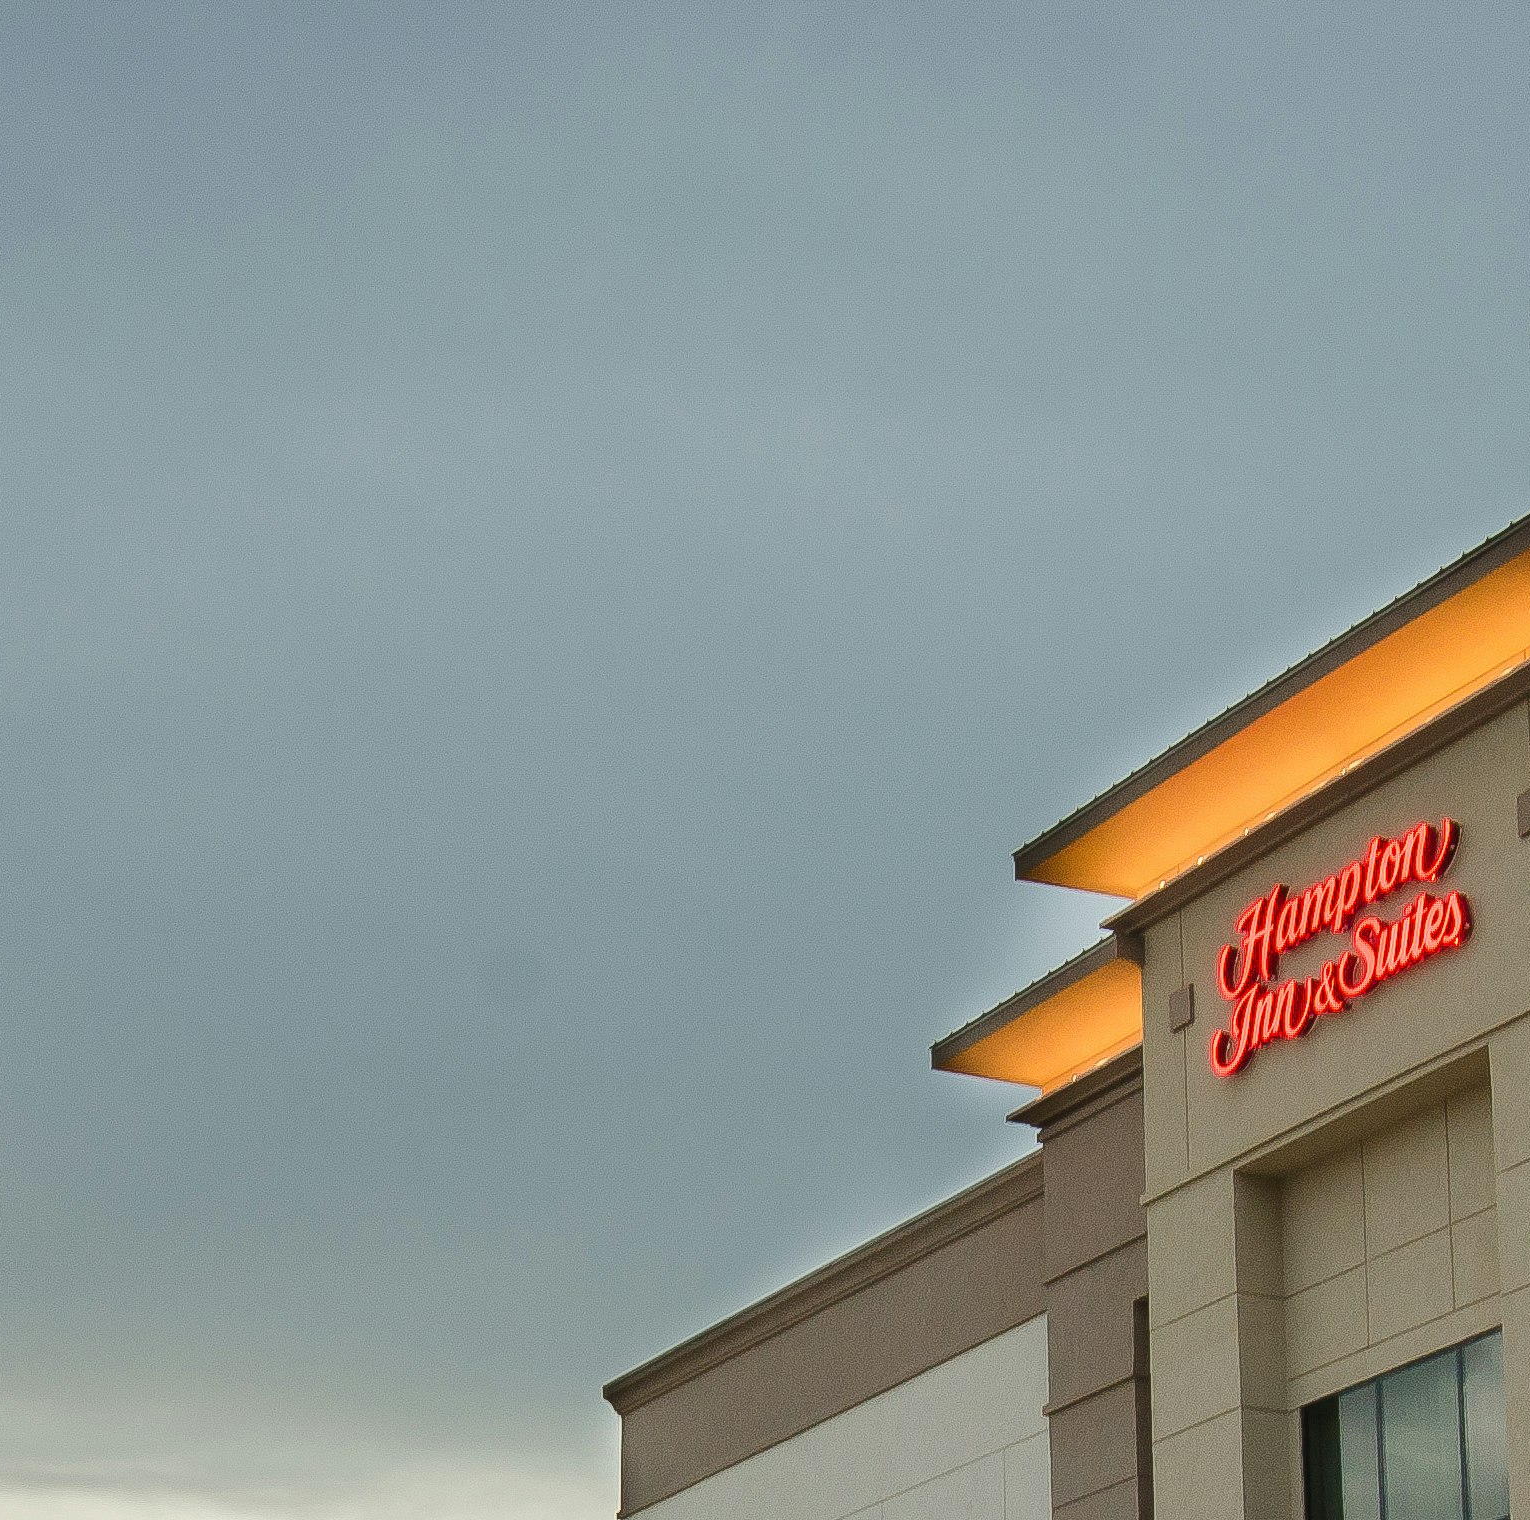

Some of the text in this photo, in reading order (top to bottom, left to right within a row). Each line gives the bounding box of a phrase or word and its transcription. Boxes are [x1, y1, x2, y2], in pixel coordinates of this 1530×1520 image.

[1210, 889, 1470, 1078] Inn & Suites
[1217, 816, 1462, 1000] Hampton
